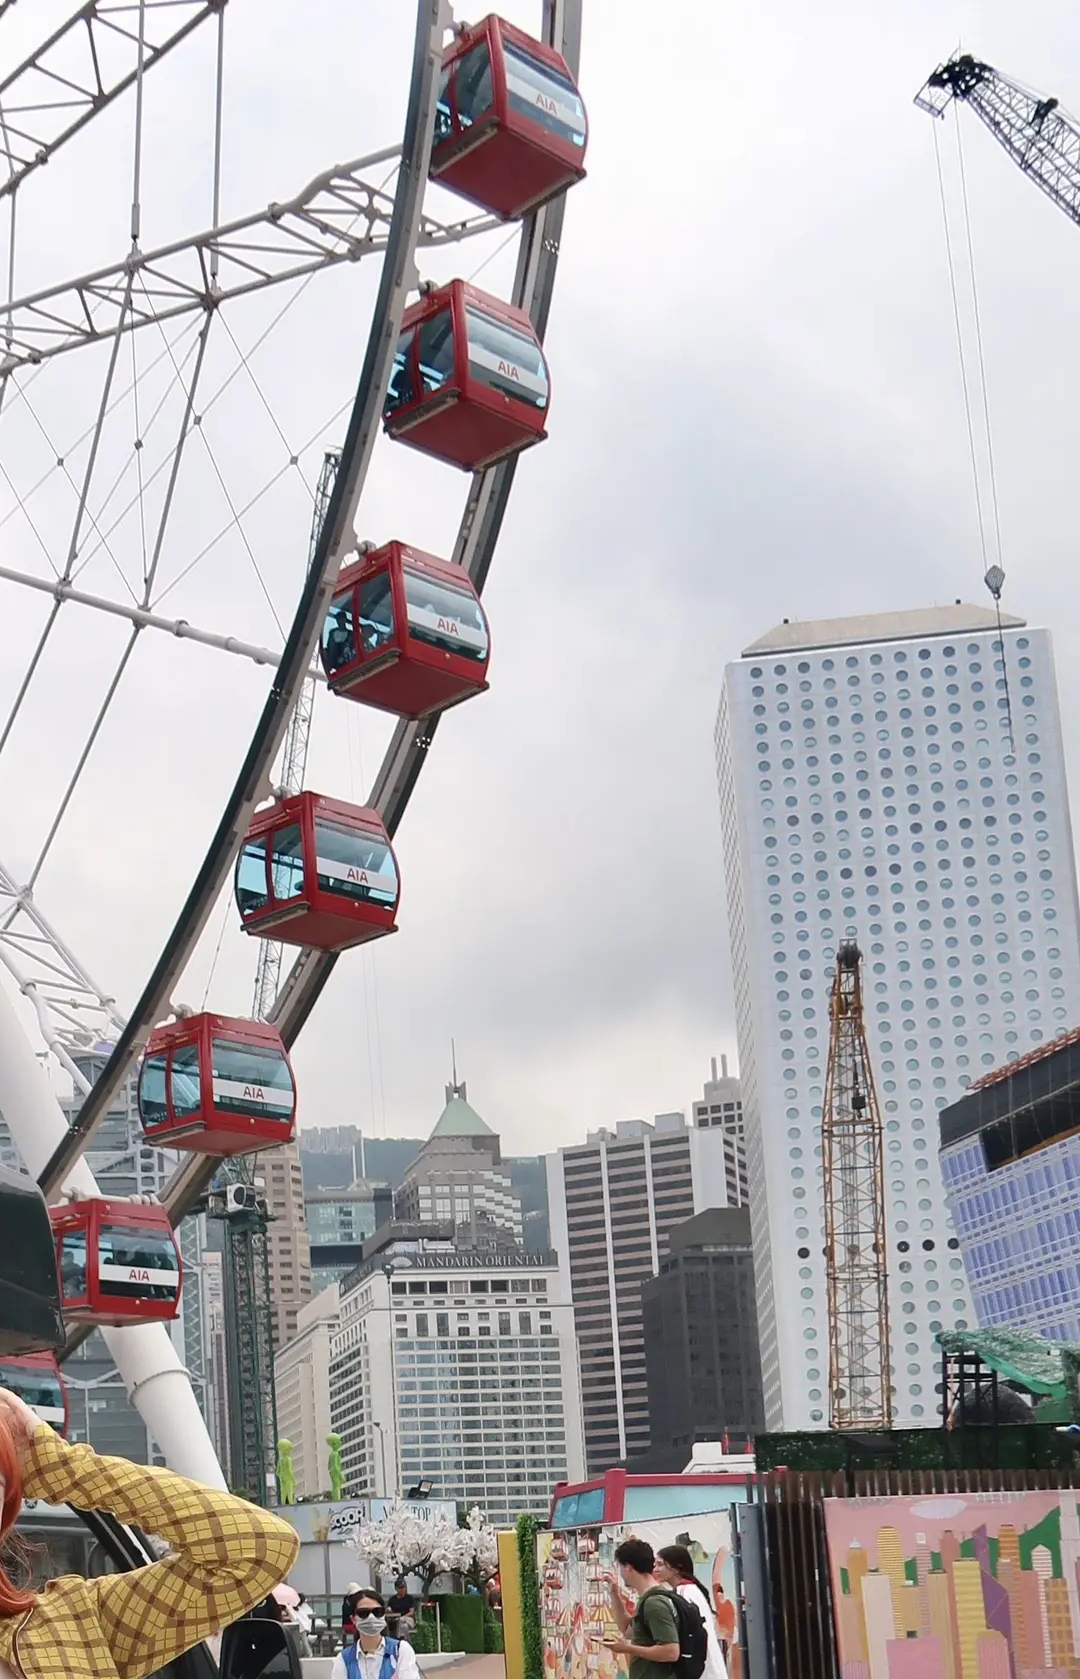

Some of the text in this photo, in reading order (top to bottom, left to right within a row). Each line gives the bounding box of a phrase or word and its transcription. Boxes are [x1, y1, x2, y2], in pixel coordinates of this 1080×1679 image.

[535, 93, 558, 115] AIA
[497, 360, 520, 381] AIA
[436, 616, 459, 636] AIA
[346, 867, 369, 884] AIA
[242, 1085, 265, 1100] AIA
[415, 1256, 483, 1269] MANDARIN
[128, 1269, 150, 1282] AIA
